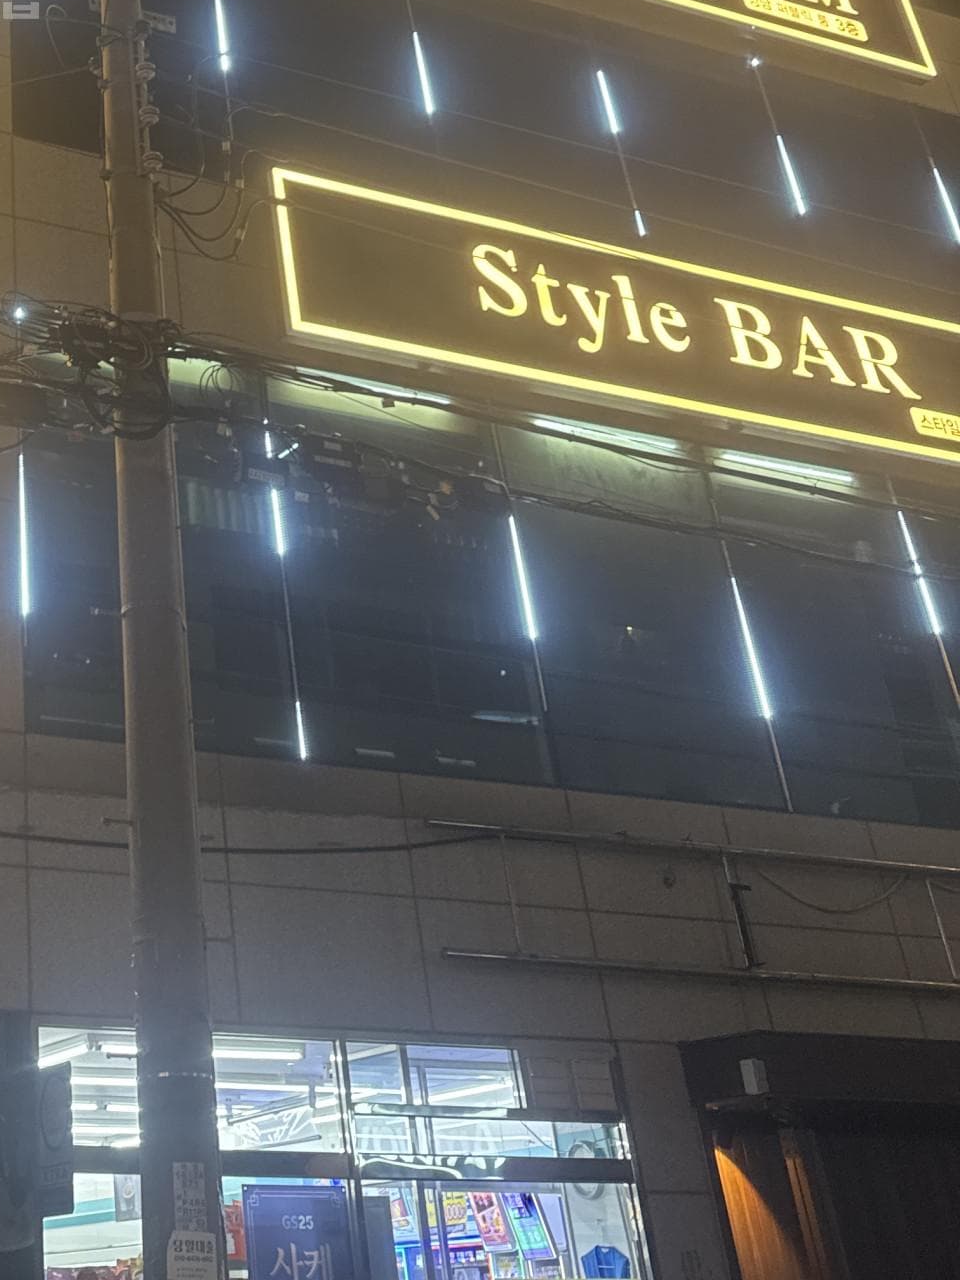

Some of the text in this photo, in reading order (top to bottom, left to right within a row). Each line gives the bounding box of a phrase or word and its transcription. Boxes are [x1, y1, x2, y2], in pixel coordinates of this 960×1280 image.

[472, 243, 922, 400] Style BAR
[281, 1215, 315, 1231] GS25
